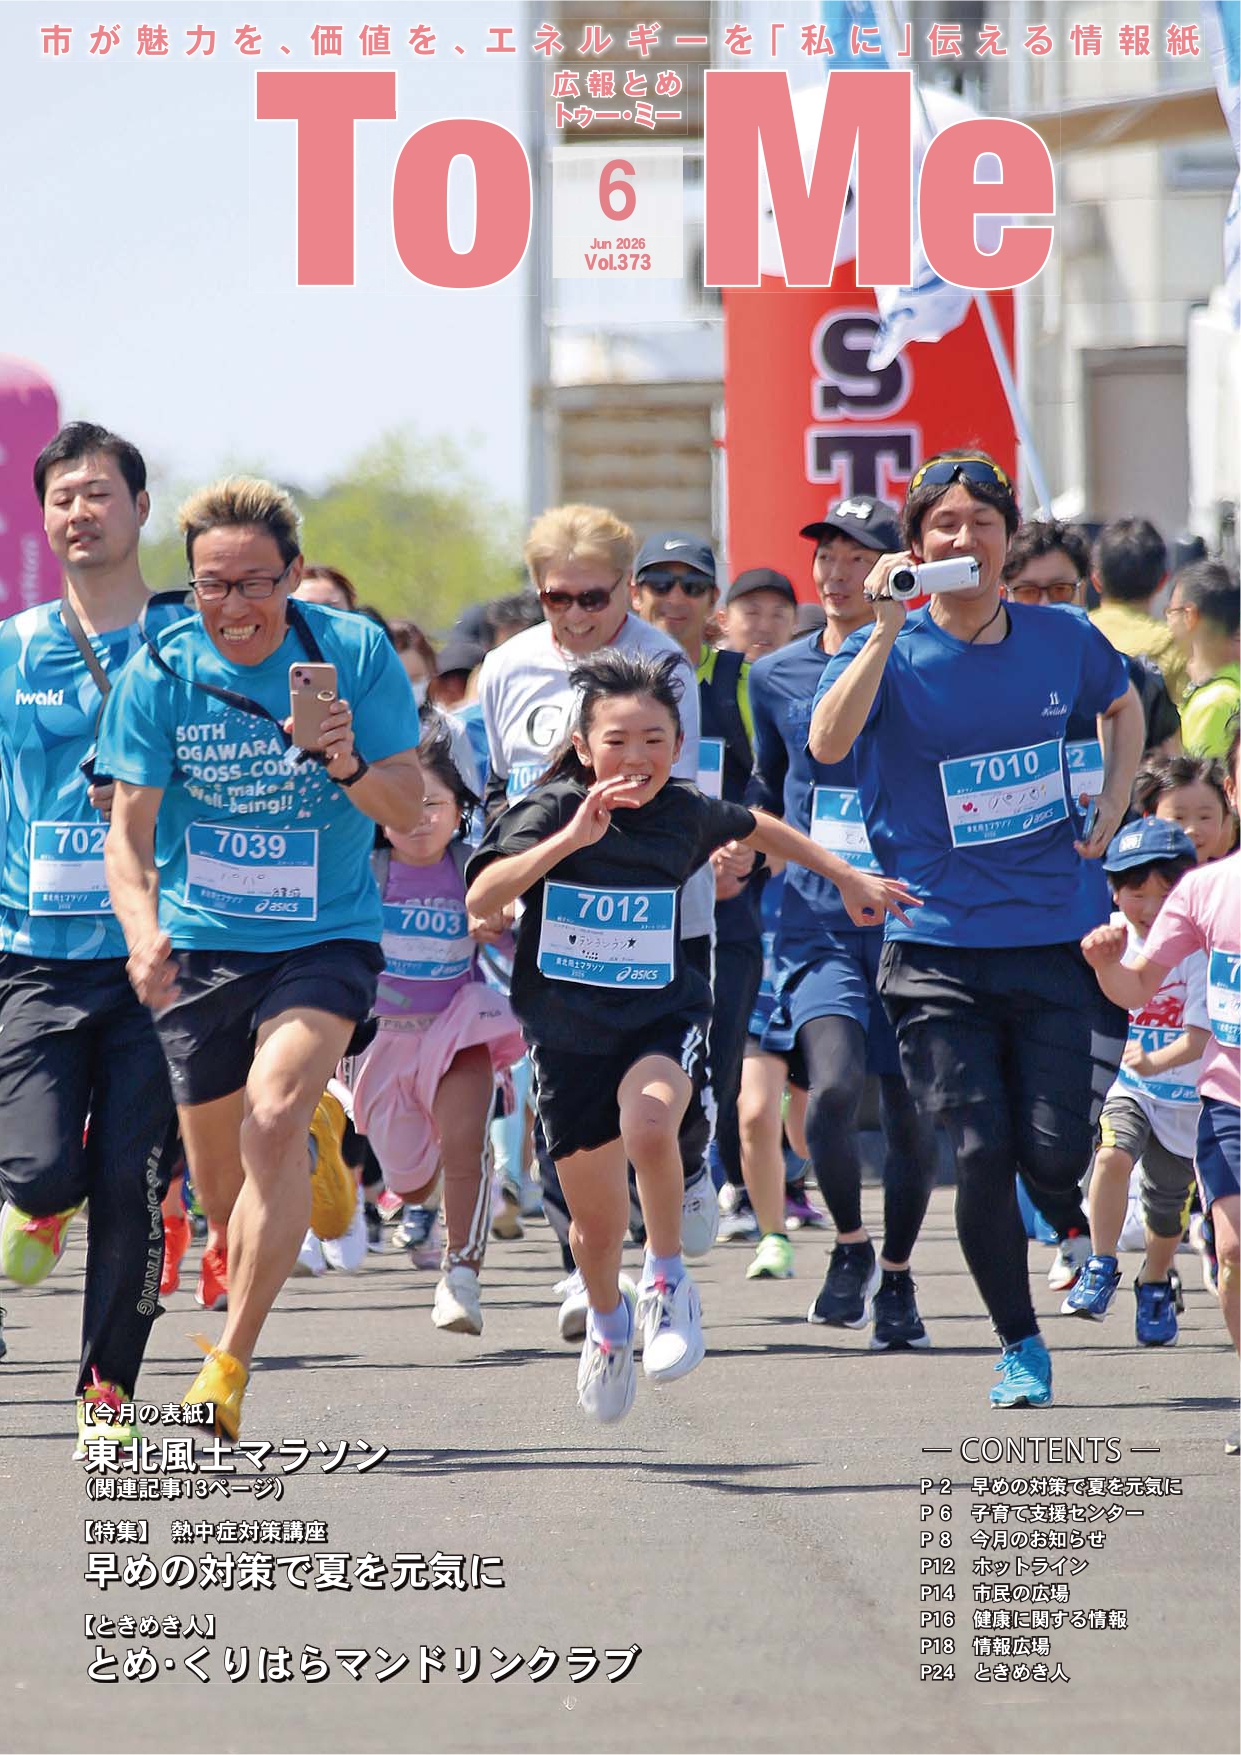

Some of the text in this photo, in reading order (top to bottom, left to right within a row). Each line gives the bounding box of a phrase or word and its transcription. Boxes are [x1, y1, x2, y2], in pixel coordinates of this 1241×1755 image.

[15, 688, 64, 706] iwaki
[175, 723, 226, 743] 50TH
[176, 738, 283, 763] OGAWARA
[970, 751, 1039, 785] 7010
[214, 830, 287, 859] 7039
[269, 902, 298, 912] asics
[577, 893, 650, 922] 7012
[401, 909, 461, 935] 7003
[630, 969, 659, 980] asics
